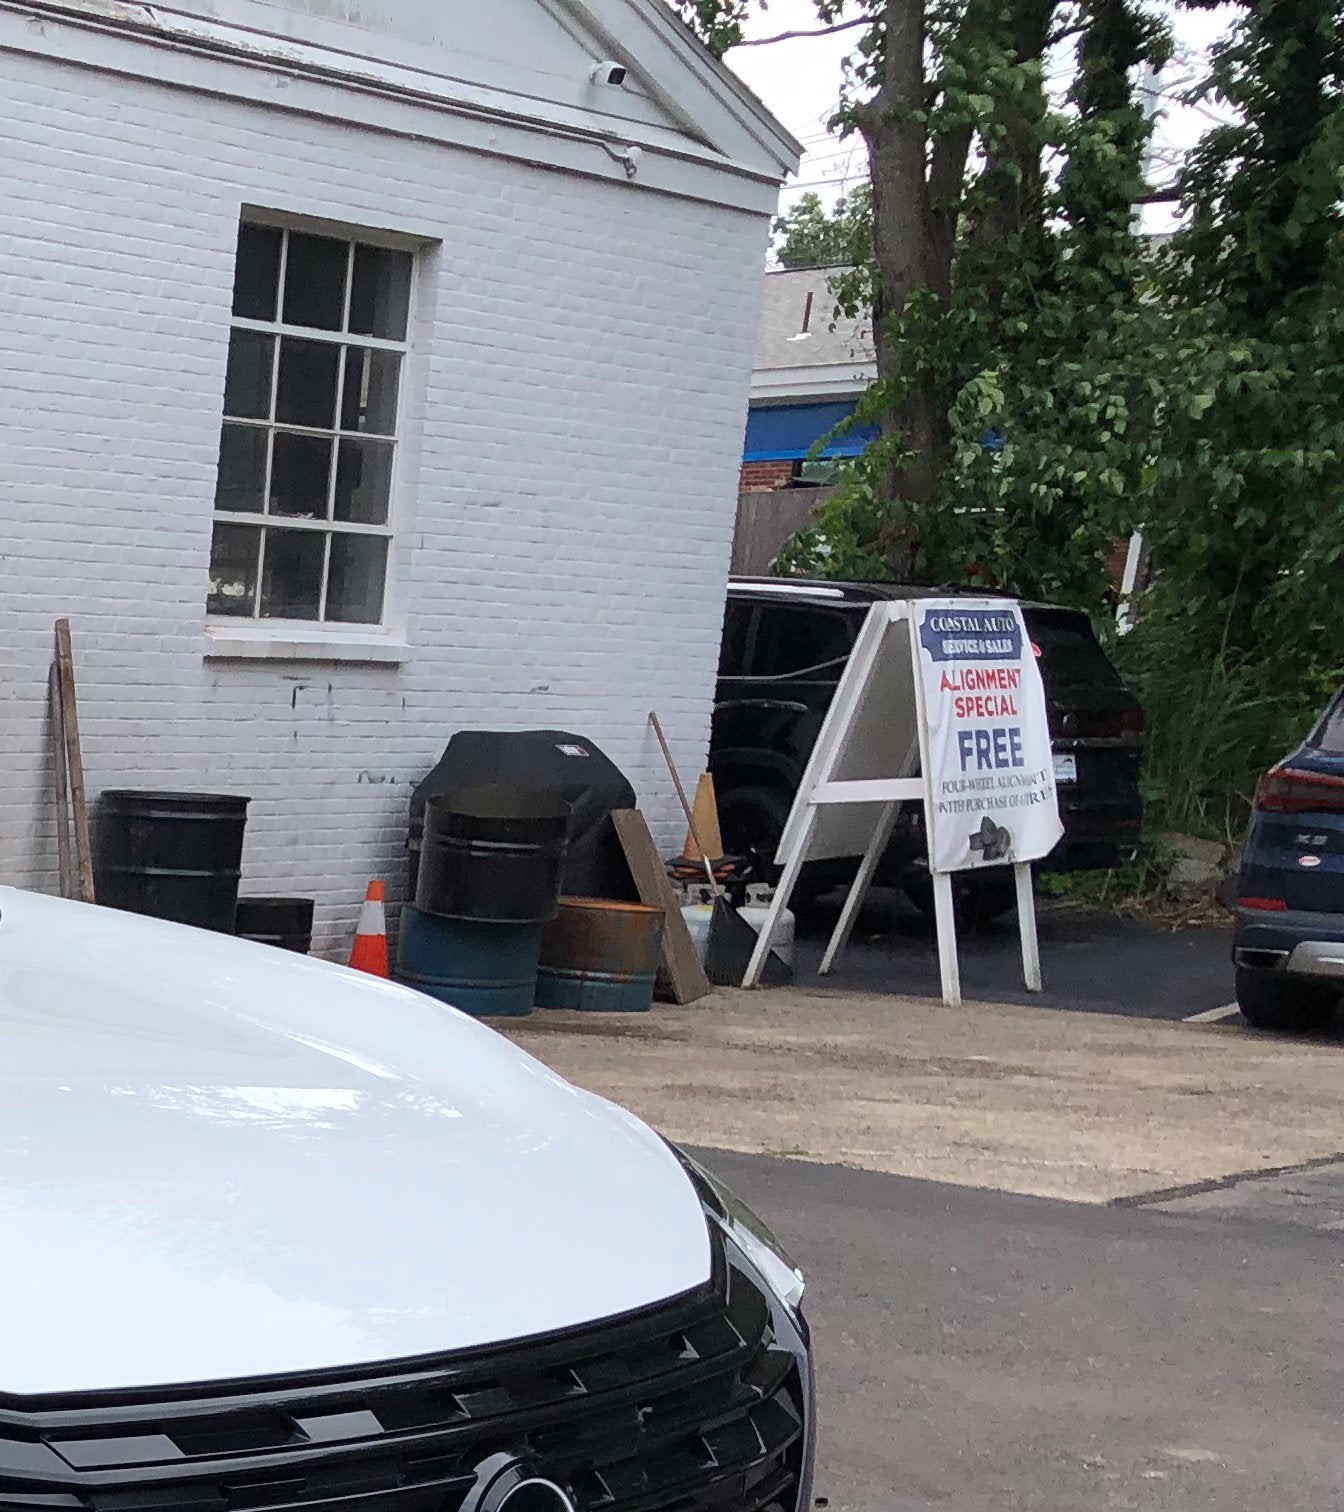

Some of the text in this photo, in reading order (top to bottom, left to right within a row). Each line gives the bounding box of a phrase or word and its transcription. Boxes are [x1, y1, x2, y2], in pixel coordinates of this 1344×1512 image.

[930, 616, 1015, 632] COASTAL AUTO
[985, 638, 1013, 653] SALES
[940, 668, 1022, 693] ALIGNMENT
[954, 695, 1018, 718] SPECIAL
[957, 727, 1025, 772] FREE
